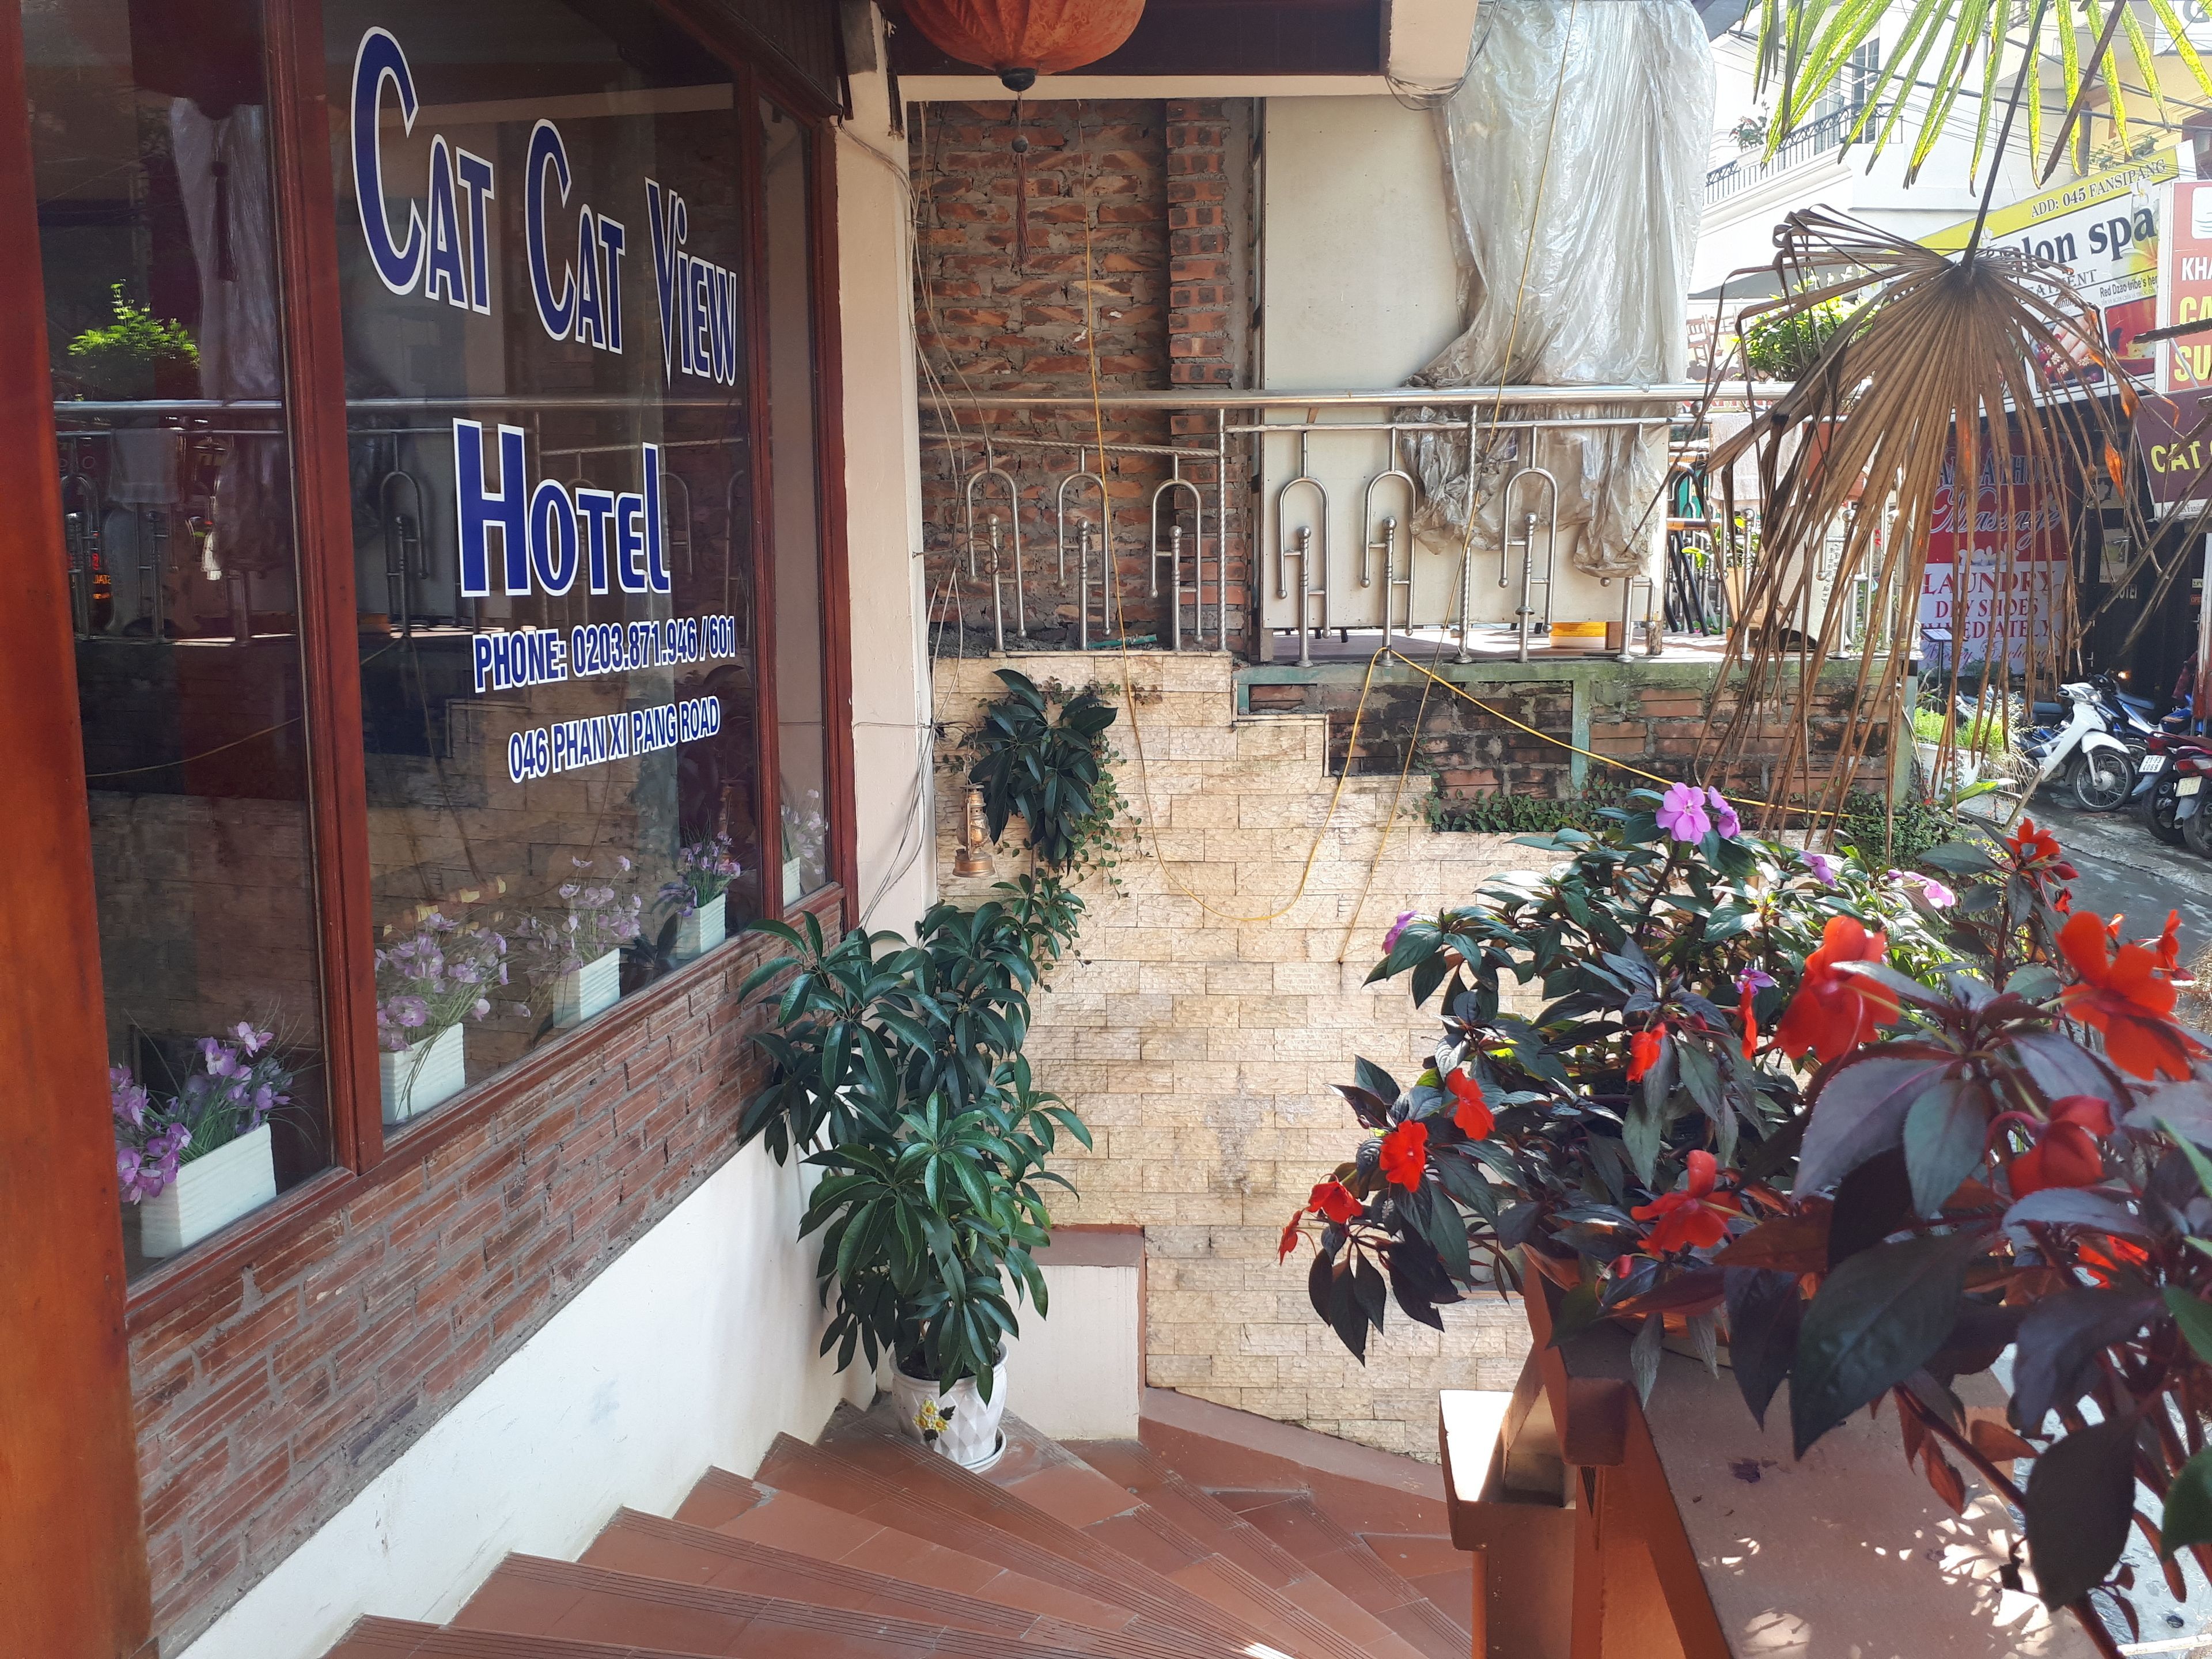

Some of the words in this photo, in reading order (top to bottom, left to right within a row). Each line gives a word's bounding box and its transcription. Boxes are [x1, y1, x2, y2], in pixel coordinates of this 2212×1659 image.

[2031, 198, 2059, 218] ADD:
[2062, 186, 2086, 206] 045
[2089, 158, 2166, 198] FANSIPANG
[2088, 207, 2157, 262] spa
[2100, 285, 2112, 298] Red
[2112, 282, 2128, 296] Dzao
[2150, 440, 2201, 473] CAT
[472, 628, 567, 693] PHONE:
[572, 617, 698, 678] 0203.871.946
[507, 727, 550, 783] 046
[551, 715, 607, 774] PHAN
[608, 712, 630, 760] XI
[630, 703, 677, 755] PANG
[679, 695, 721, 744] ROAD
